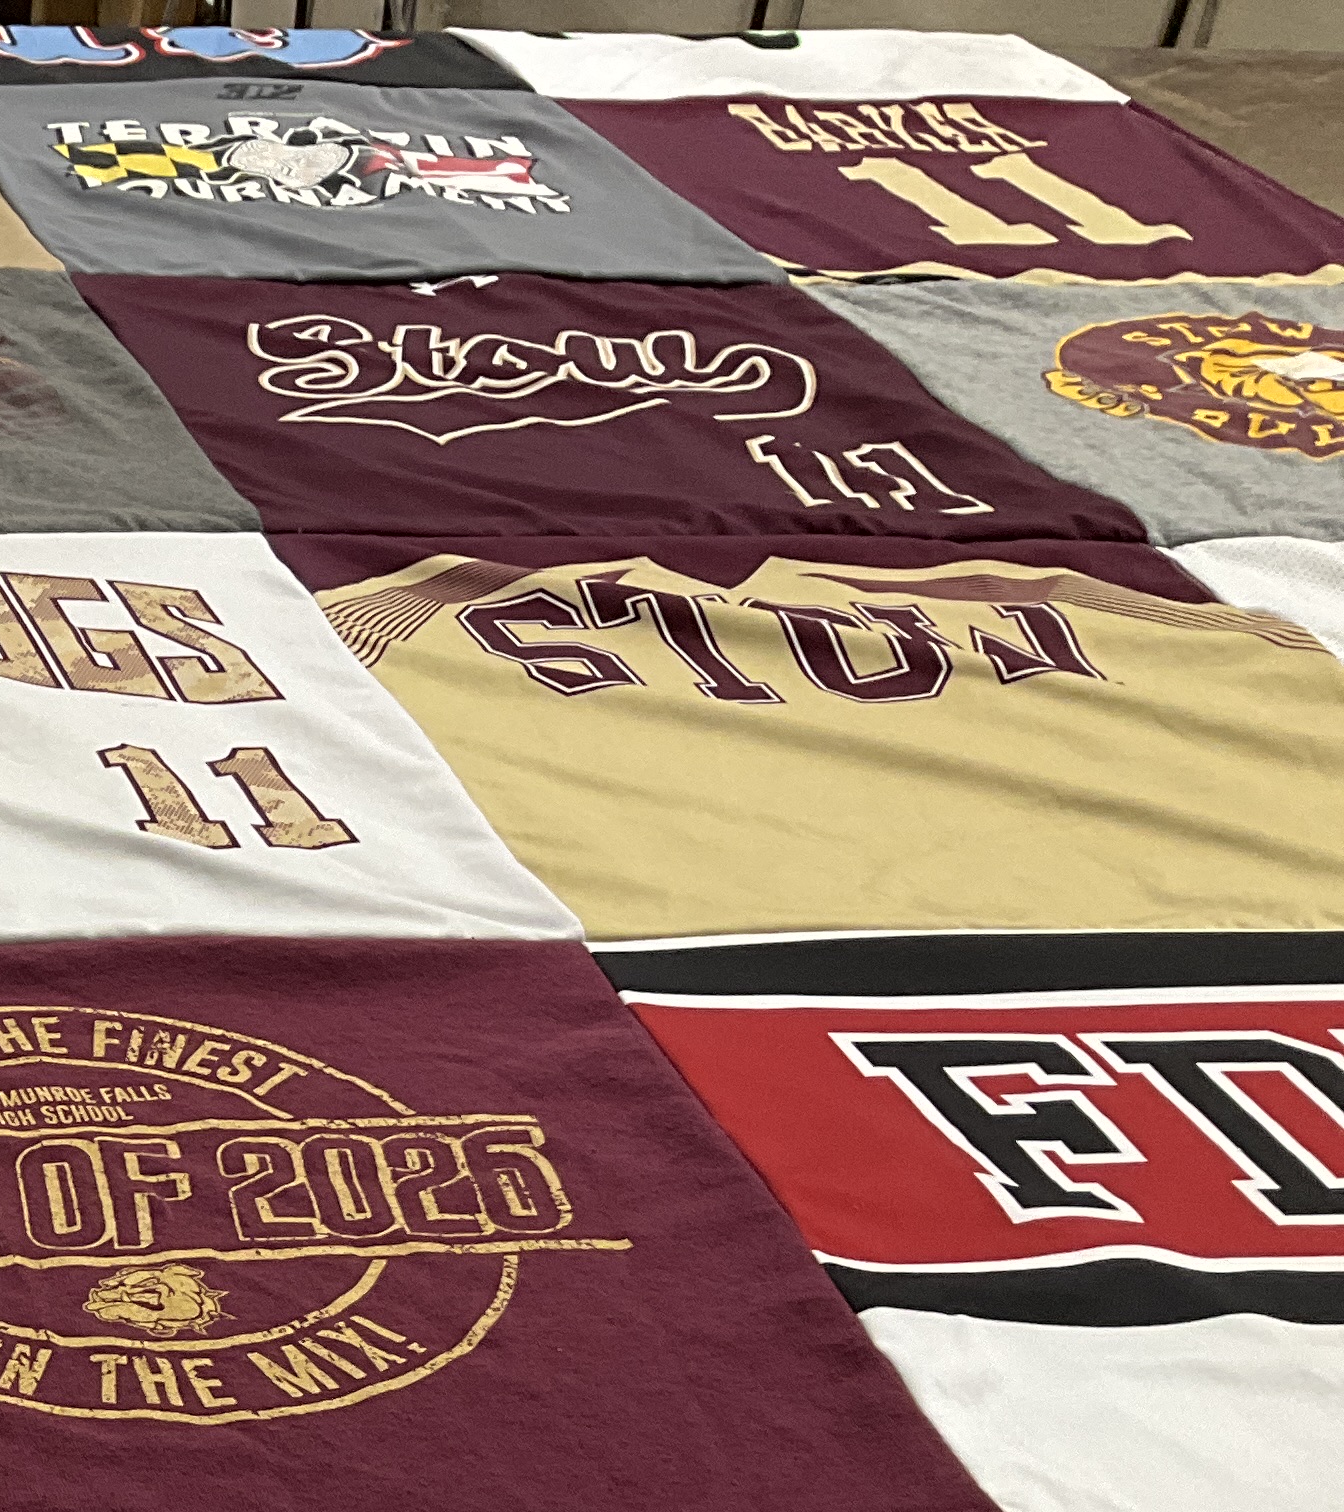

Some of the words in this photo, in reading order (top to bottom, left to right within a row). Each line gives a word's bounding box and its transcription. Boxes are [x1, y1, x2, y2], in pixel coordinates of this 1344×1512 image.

[726, 102, 1049, 153] BARKER
[837, 153, 1195, 246] 11
[249, 314, 816, 425] Stow
[746, 435, 993, 514] 11
[455, 577, 1109, 705] STOW
[95, 743, 363, 850] 11
[90, 1020, 313, 1097] FINEST
[97, 1083, 174, 1104] FALLS
[41, 1104, 134, 1125] SCHOOL
[827, 1028, 1344, 1226] FD
[14, 1136, 193, 1251] OF
[215, 1123, 576, 1242] 2026
[88, 1348, 240, 1408] THE
[246, 1314, 429, 1399] MIX!
